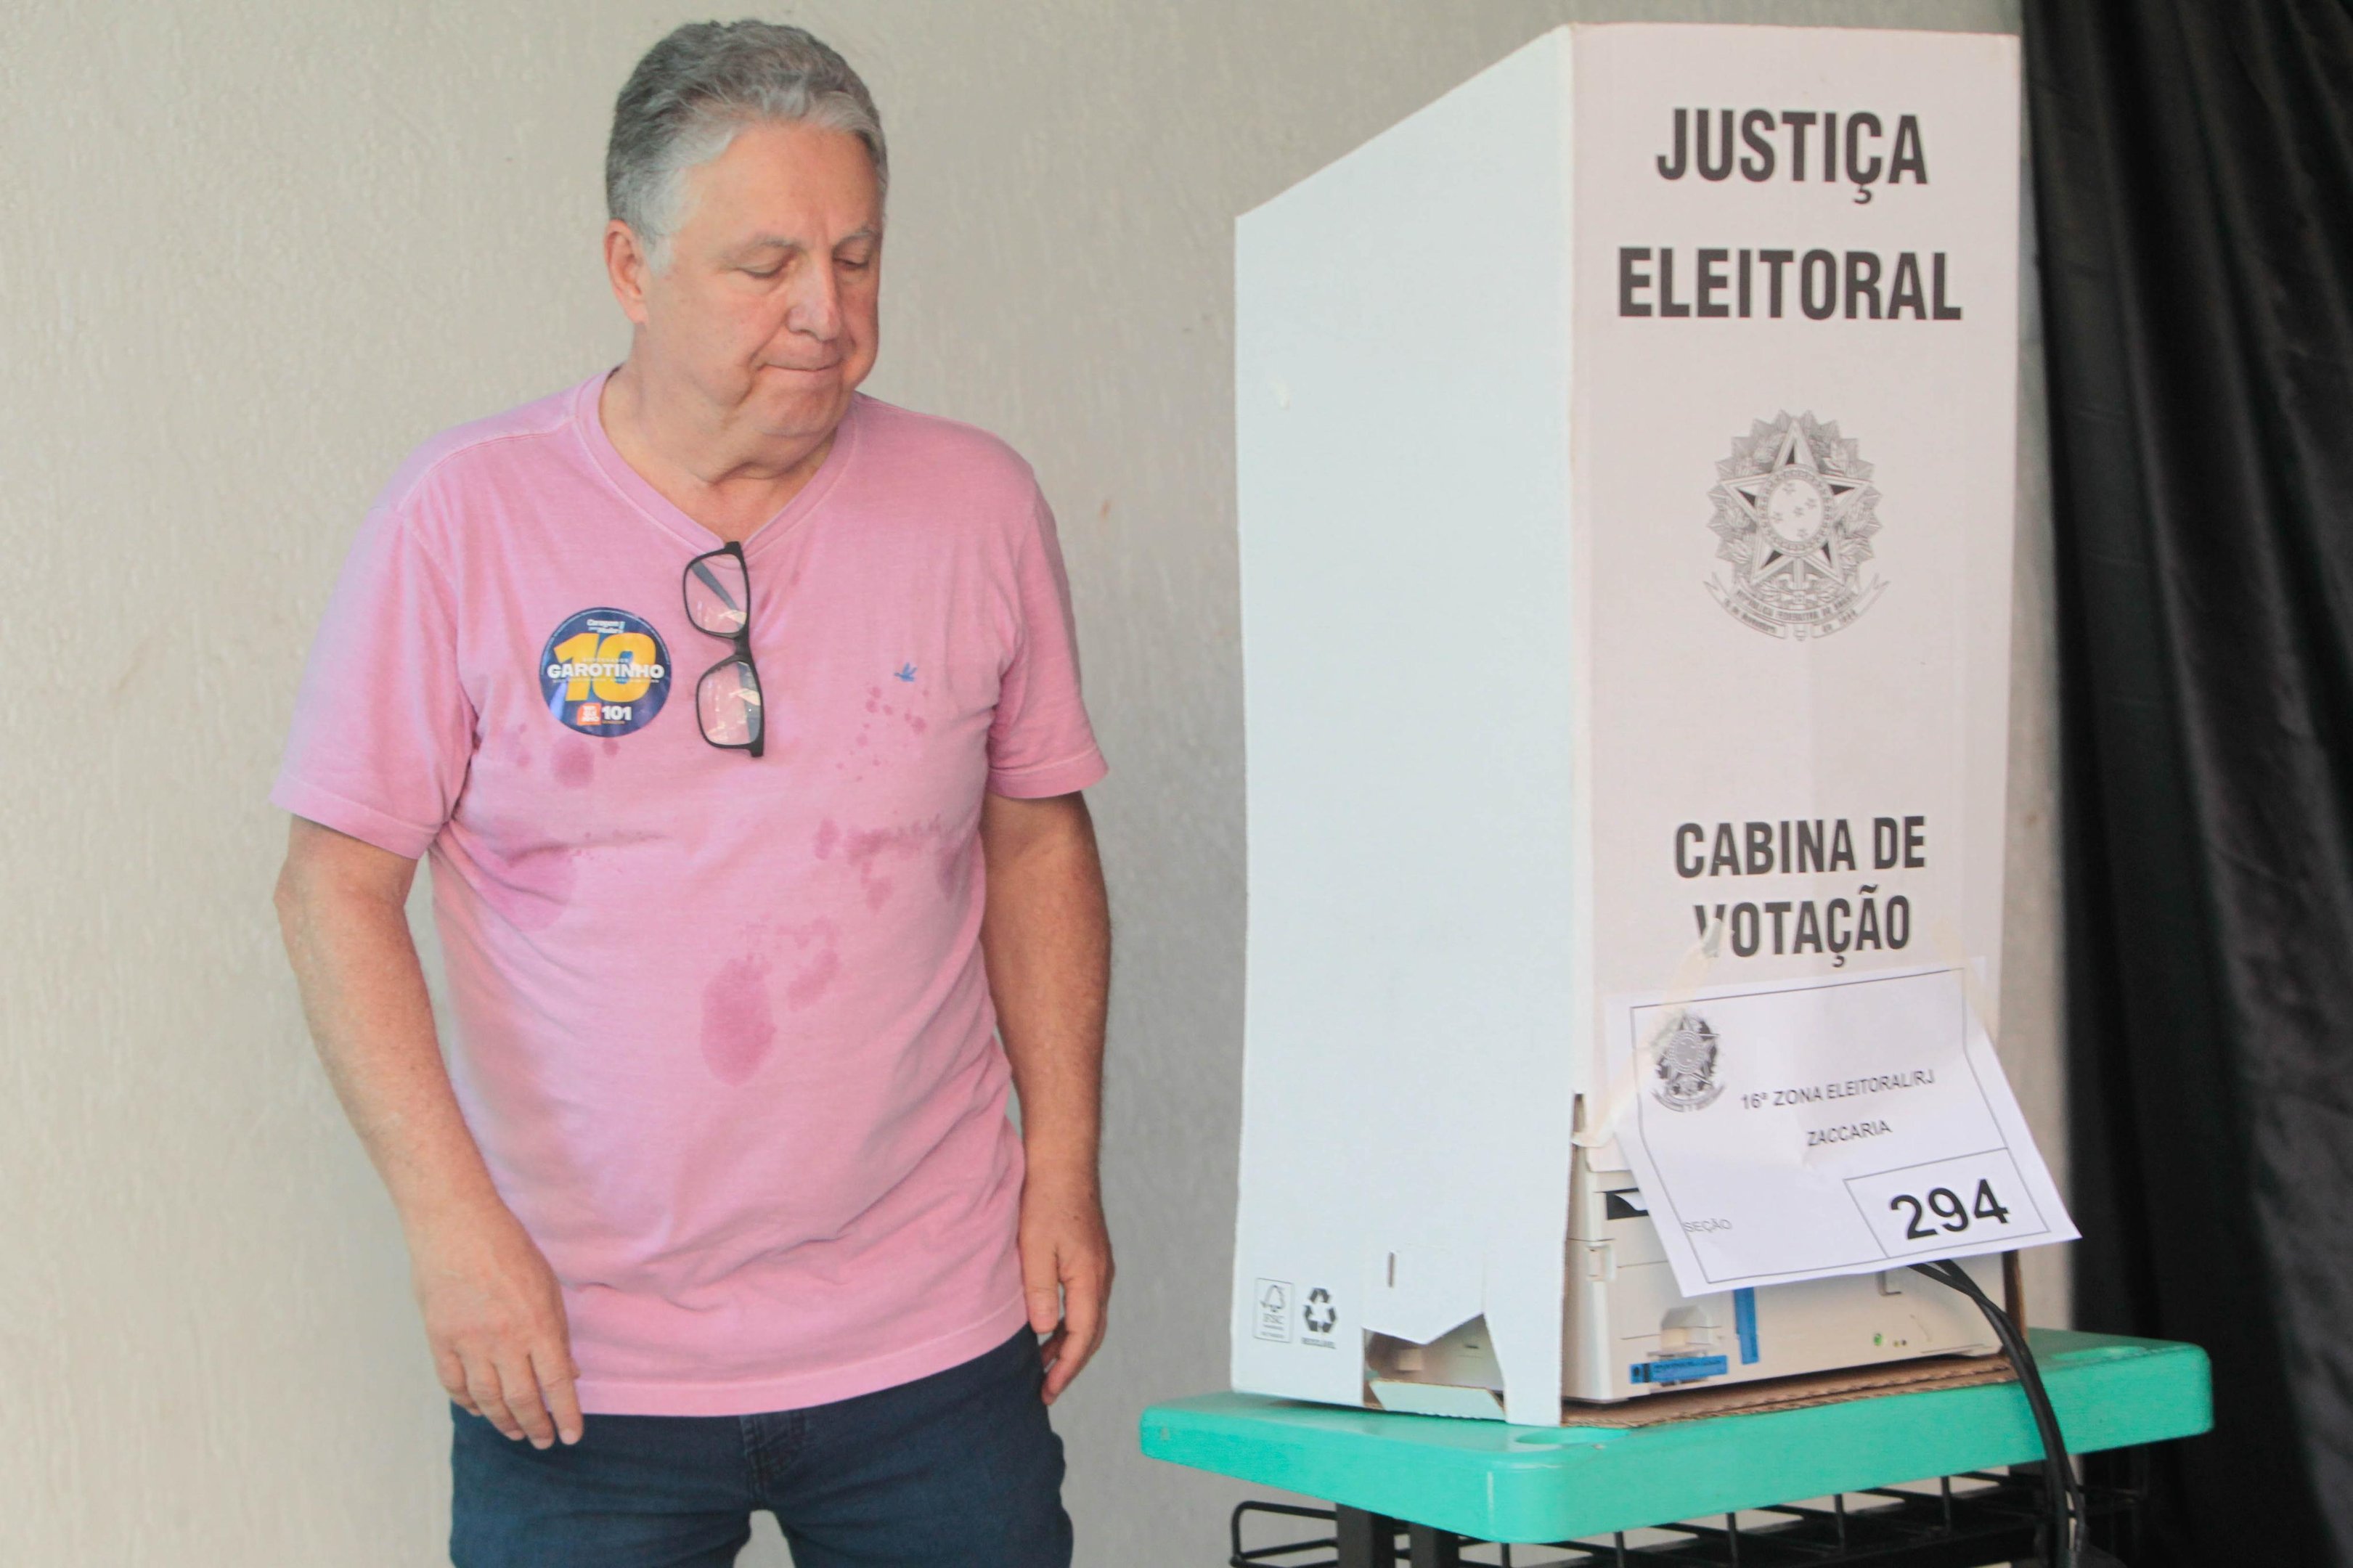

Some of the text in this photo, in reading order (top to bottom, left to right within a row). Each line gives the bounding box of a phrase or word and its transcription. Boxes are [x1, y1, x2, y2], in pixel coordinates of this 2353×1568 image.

[1656, 107, 1928, 205] JUSTIÇA
[1618, 246, 1962, 321] ELEITORAL
[547, 663, 665, 679] GAROTINHO
[553, 632, 656, 703] 10
[602, 705, 632, 721] 101
[1675, 815, 1925, 878] CABINA DE
[1772, 1086, 1824, 1107] ZONA
[1825, 1069, 1936, 1100] ELEITORAL/RJ
[1806, 1119, 1893, 1147] ZACCARIA
[1681, 1178, 2010, 1240] SEÇÃO 294
